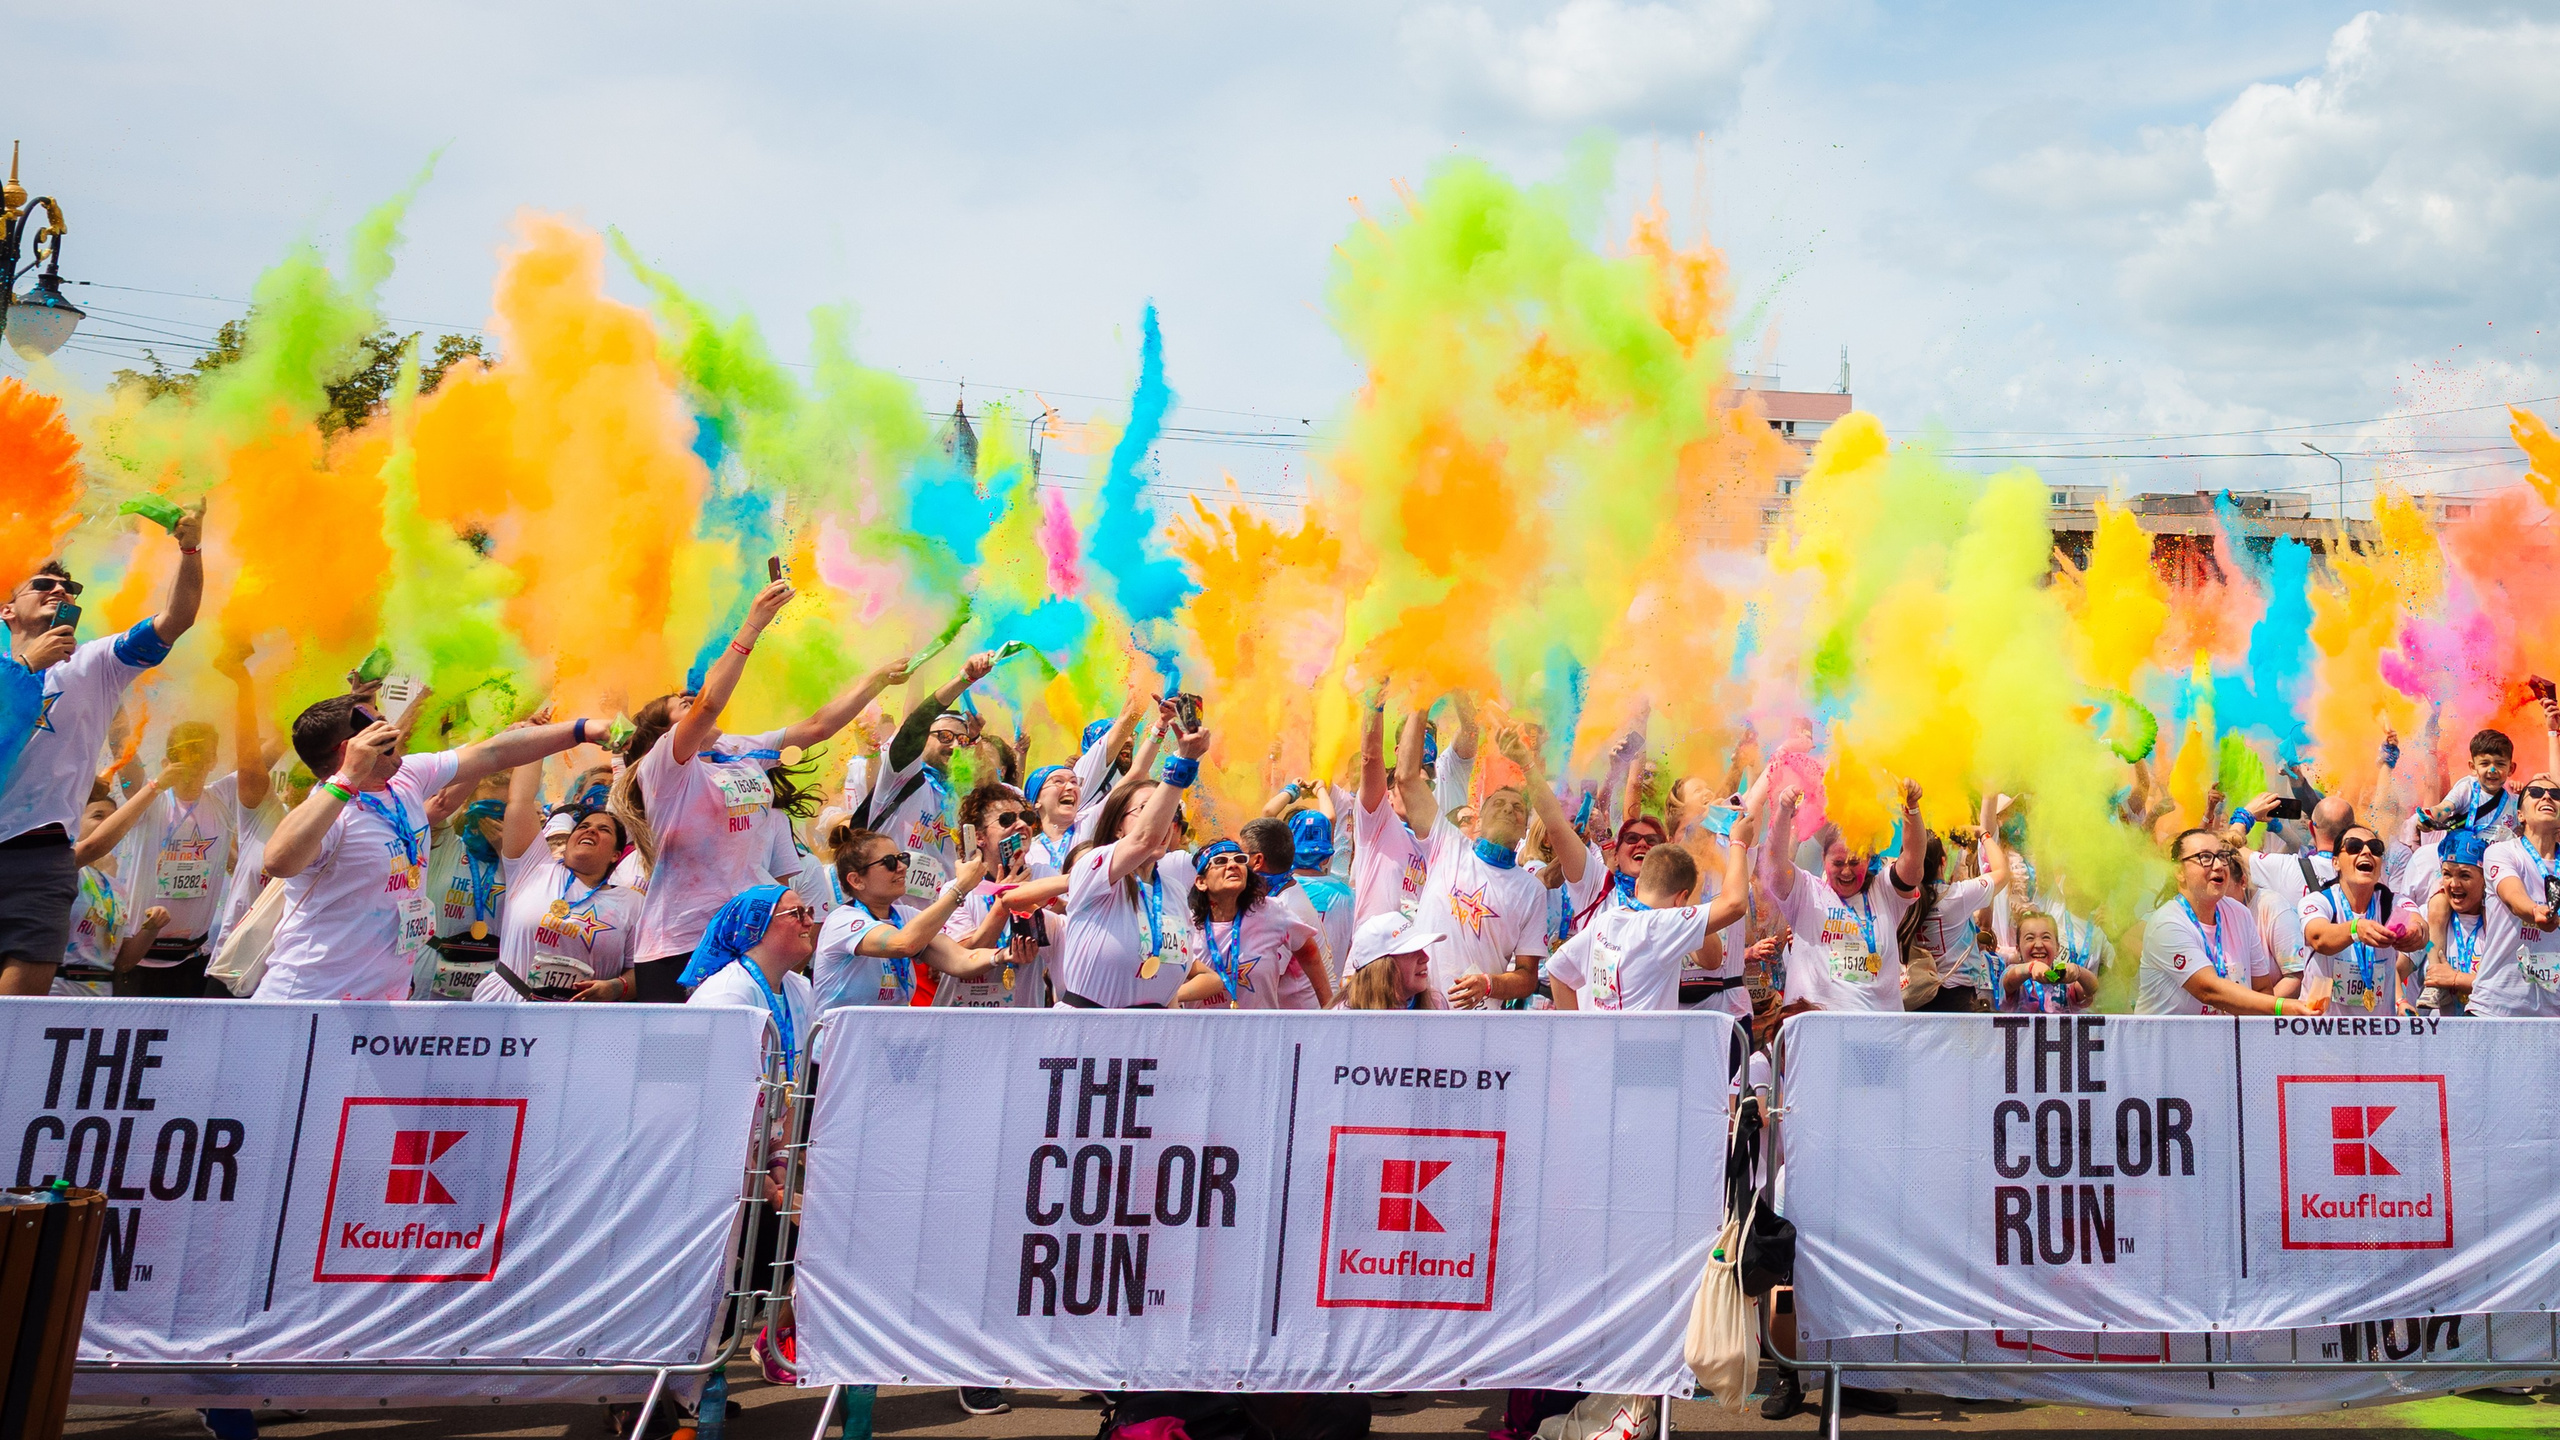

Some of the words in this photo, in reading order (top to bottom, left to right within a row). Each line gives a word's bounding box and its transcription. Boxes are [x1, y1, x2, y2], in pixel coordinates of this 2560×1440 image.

[733, 779, 761, 794] 16345
[173, 874, 201, 889] 15282
[451, 876, 473, 890] THE
[910, 869, 936, 889] 17564
[445, 890, 475, 907] COLO
[1827, 907, 1846, 921] THE
[405, 916, 428, 939] 15390
[449, 971, 481, 988] 18462
[543, 970, 578, 989] 15771
[2274, 1017, 2401, 1036] POWERED
[2410, 1017, 2441, 1036] BY
[351, 1035, 491, 1057] POWERED
[500, 1037, 538, 1057] BY
[1993, 1016, 2107, 1094] THE
[43, 1027, 169, 1111] THE
[1333, 1065, 1468, 1089] POWERED
[1476, 1070, 1512, 1091] BY
[1038, 1057, 1158, 1139] THE
[1993, 1097, 2196, 1179] COLOR
[15, 1115, 245, 1201] COLOR
[1025, 1144, 1240, 1228] COLOR
[2301, 1193, 2433, 1219] Kaufland
[340, 1222, 485, 1250] Kaufland
[1994, 1184, 2116, 1266] RUN
[1016, 1233, 1150, 1317] RUN
[1339, 1248, 1476, 1278] Kaufland
